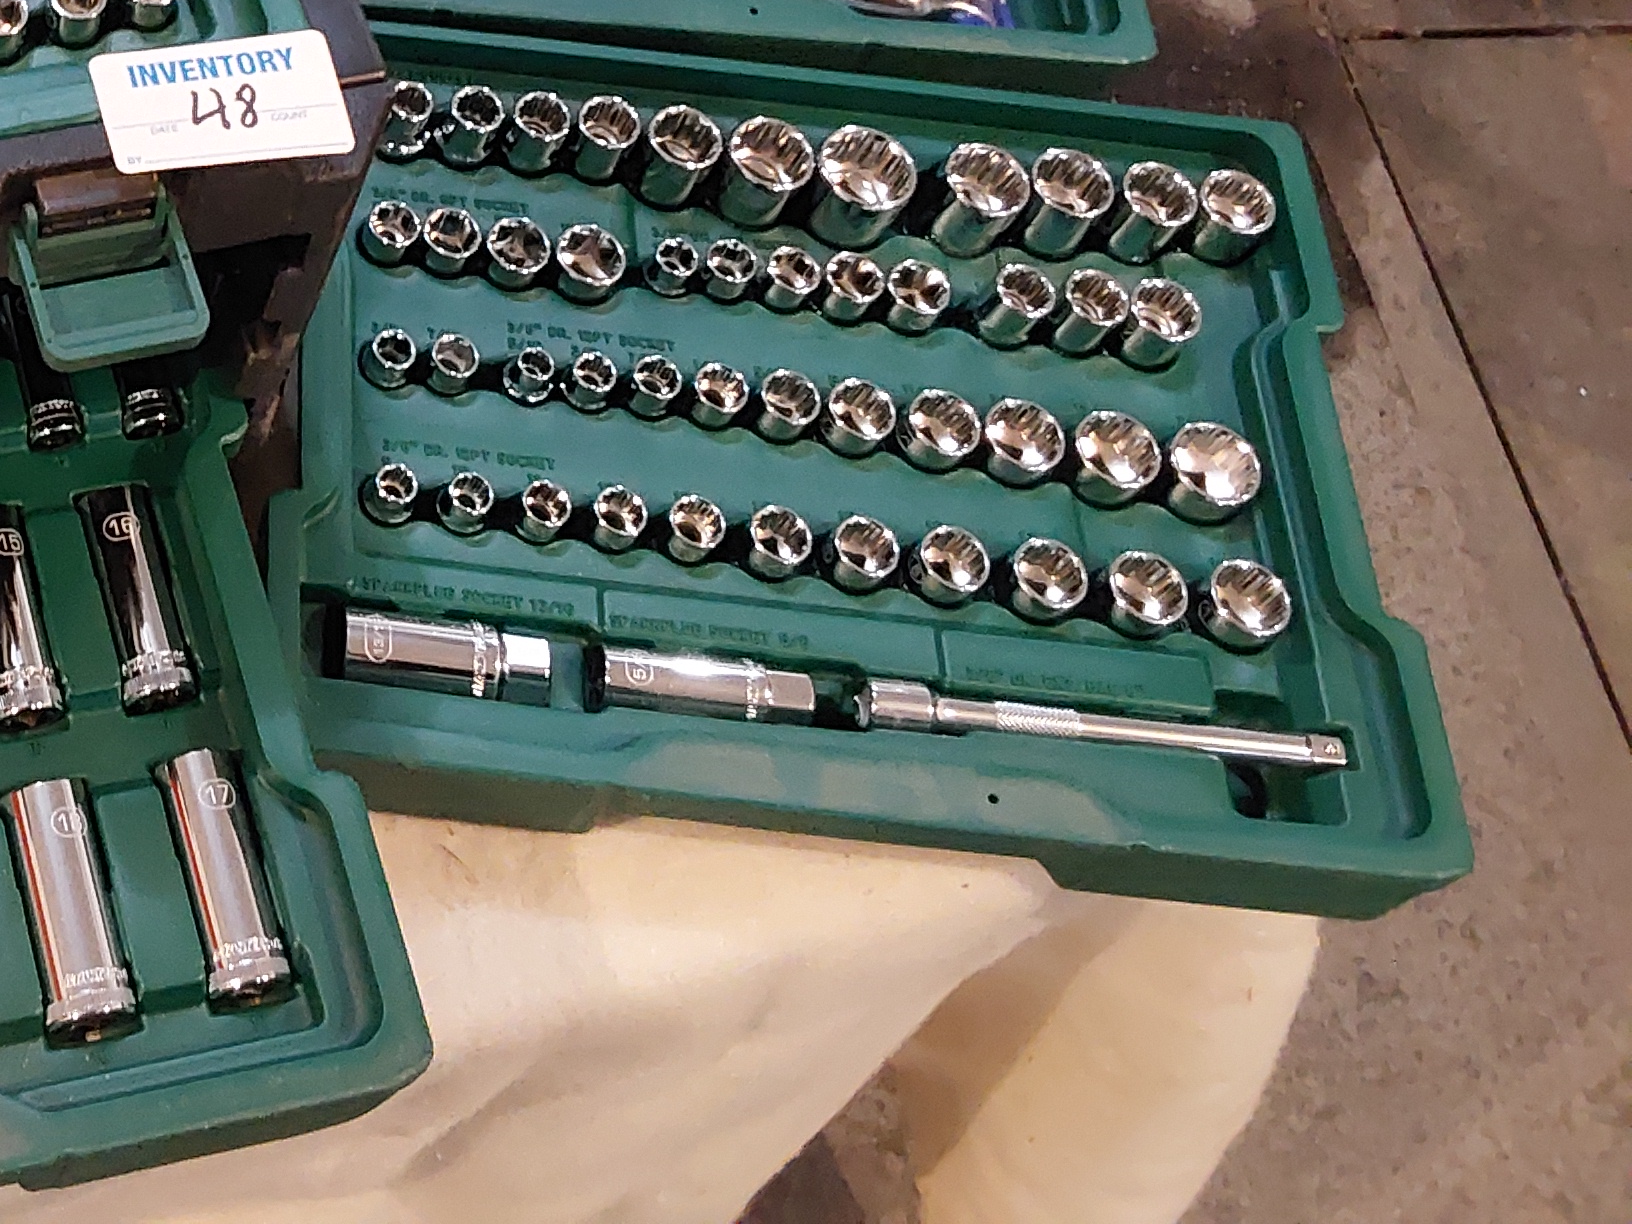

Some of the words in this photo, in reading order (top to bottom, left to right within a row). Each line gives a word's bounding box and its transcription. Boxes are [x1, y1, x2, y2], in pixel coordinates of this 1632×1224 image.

[126, 47, 293, 88] INVENTORY
[191, 83, 259, 130] 48
[150, 124, 179, 135] DATE
[109, 517, 132, 535] 16
[206, 786, 230, 804] 17
